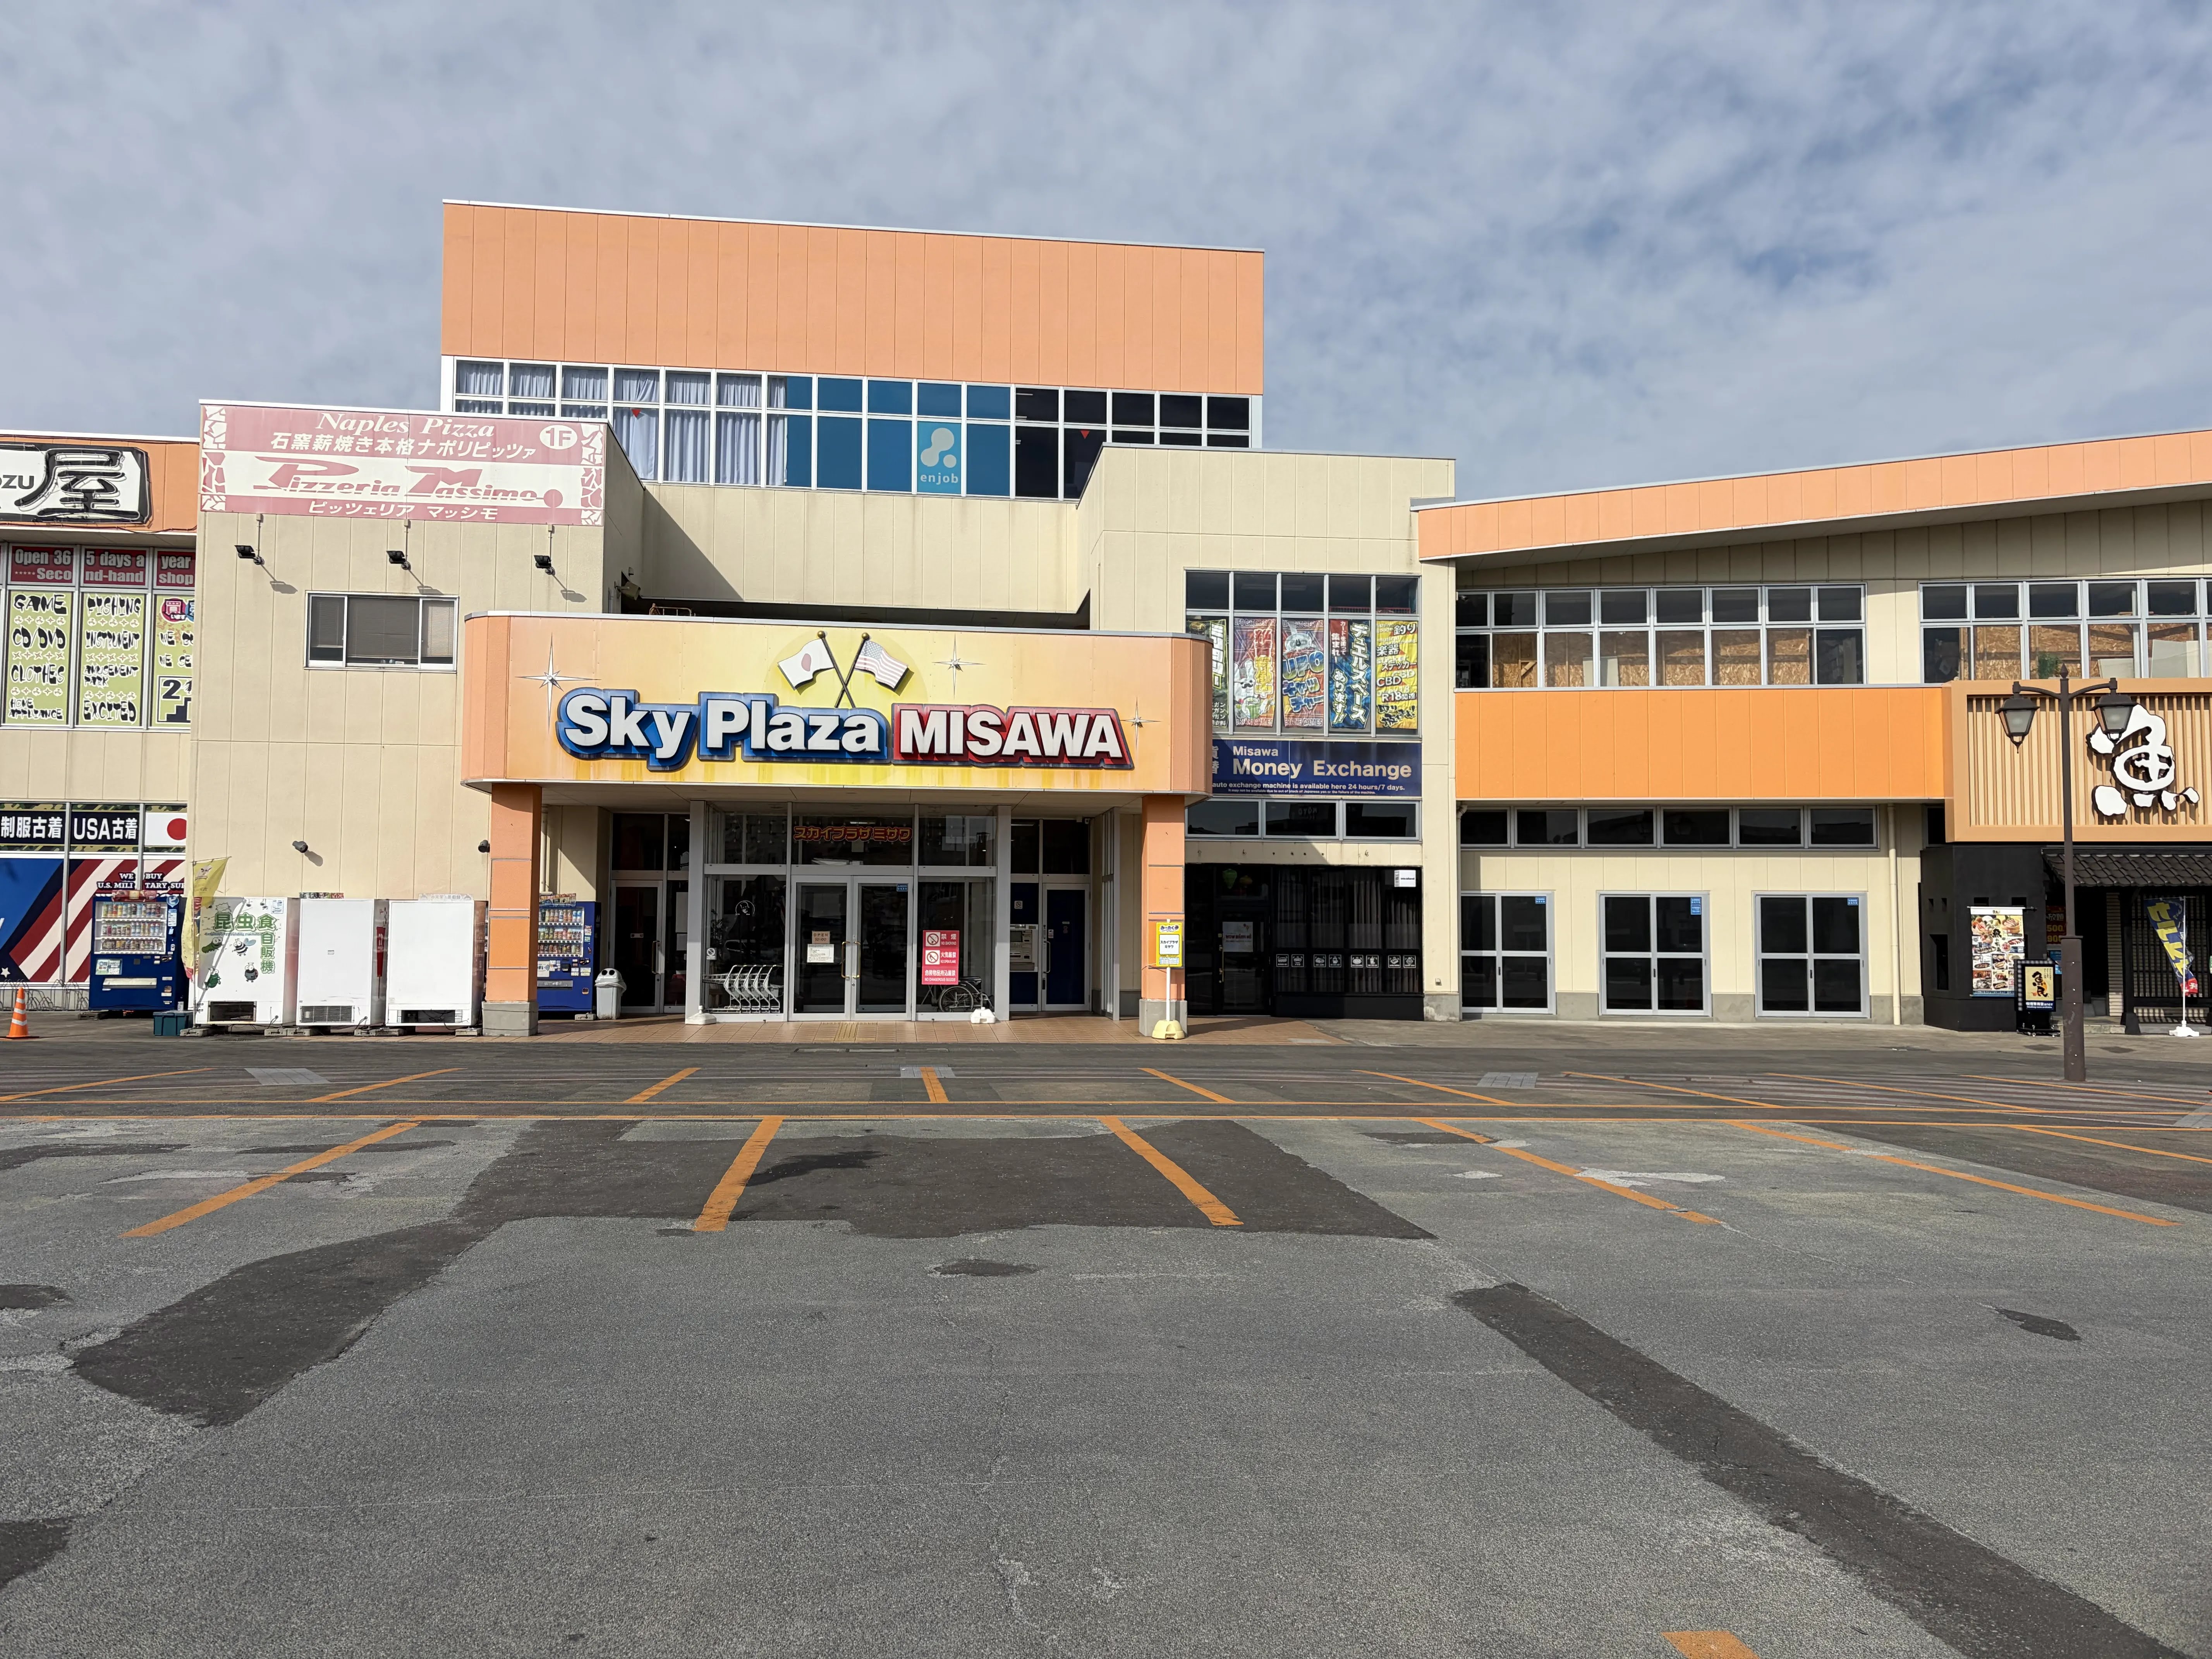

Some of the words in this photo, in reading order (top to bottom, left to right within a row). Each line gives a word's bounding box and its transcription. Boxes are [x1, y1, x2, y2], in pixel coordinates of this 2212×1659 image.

[316, 412, 410, 436] Naples
[420, 417, 495, 438] Pizza
[545, 428, 572, 447] 1F
[0, 475, 34, 489] ZU
[14, 448, 141, 520] 屋
[254, 456, 400, 496] Pizzeria
[405, 465, 537, 501] Massimo
[921, 472, 958, 485] enjob
[309, 501, 415, 517] ピッツェリア
[427, 505, 498, 520] マッシモ
[15, 549, 48, 565] Open
[100, 551, 132, 569] days
[136, 555, 144, 567] a
[161, 555, 191, 569] year
[37, 568, 72, 580] Seco
[86, 570, 144, 583] nd-hand
[159, 573, 194, 585] shop
[14, 594, 67, 615] GAME
[87, 595, 141, 616] FISHING
[12, 626, 66, 649] CD/DVD
[160, 631, 175, 646] WE
[1393, 623, 1416, 635] 釣り
[85, 630, 140, 649] INSTRUMENT
[1376, 643, 1399, 656] 楽器
[84, 665, 139, 676] AMUSEMENT
[160, 655, 173, 668] WE
[1283, 651, 1324, 679] UFO
[1382, 660, 1417, 671] ステッカー
[11, 664, 65, 684] CLOTHES
[84, 676, 109, 687] PARK
[1351, 623, 1369, 723] デュエルスペース
[1376, 676, 1402, 687] CBD
[10, 698, 34, 709] HOME
[83, 699, 137, 722] EXCITED
[9, 708, 63, 719] APPLIANCE
[565, 694, 692, 759] Sky
[706, 699, 881, 752] Plaza
[900, 709, 1123, 758] MISAWA
[1233, 746, 1278, 756] Misawa
[1233, 758, 1303, 779] Money
[1314, 760, 1412, 780] Exchange
[0, 816, 63, 839] 制服古着
[73, 817, 138, 840] USA古着
[794, 826, 872, 841] スカイプラザ
[874, 827, 912, 842] ミサワ
[214, 912, 276, 931] 昆虫食
[261, 932, 275, 974] 自販機
